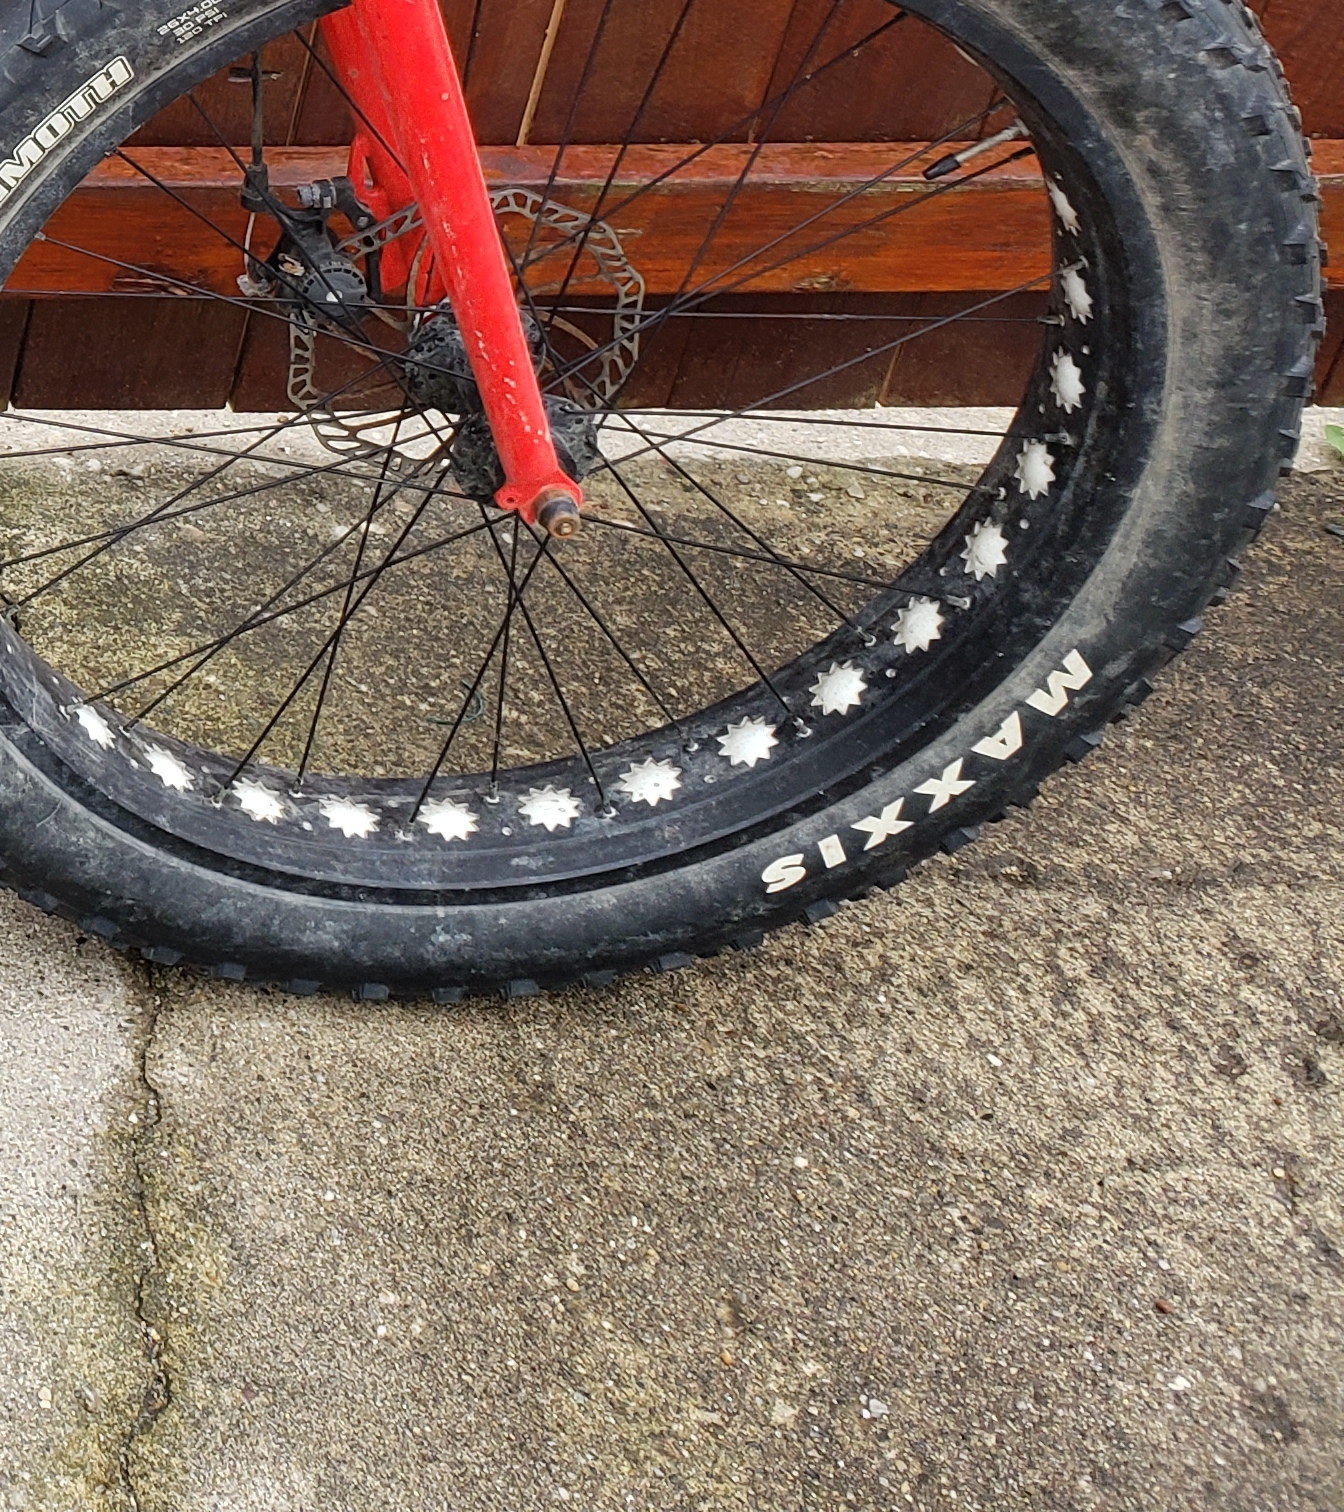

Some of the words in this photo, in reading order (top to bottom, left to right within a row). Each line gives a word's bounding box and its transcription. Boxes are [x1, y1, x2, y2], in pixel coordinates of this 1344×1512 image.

[172, 22, 195, 38] 30
[195, 6, 220, 25] PSI
[761, 648, 1094, 894] MAXXIS
